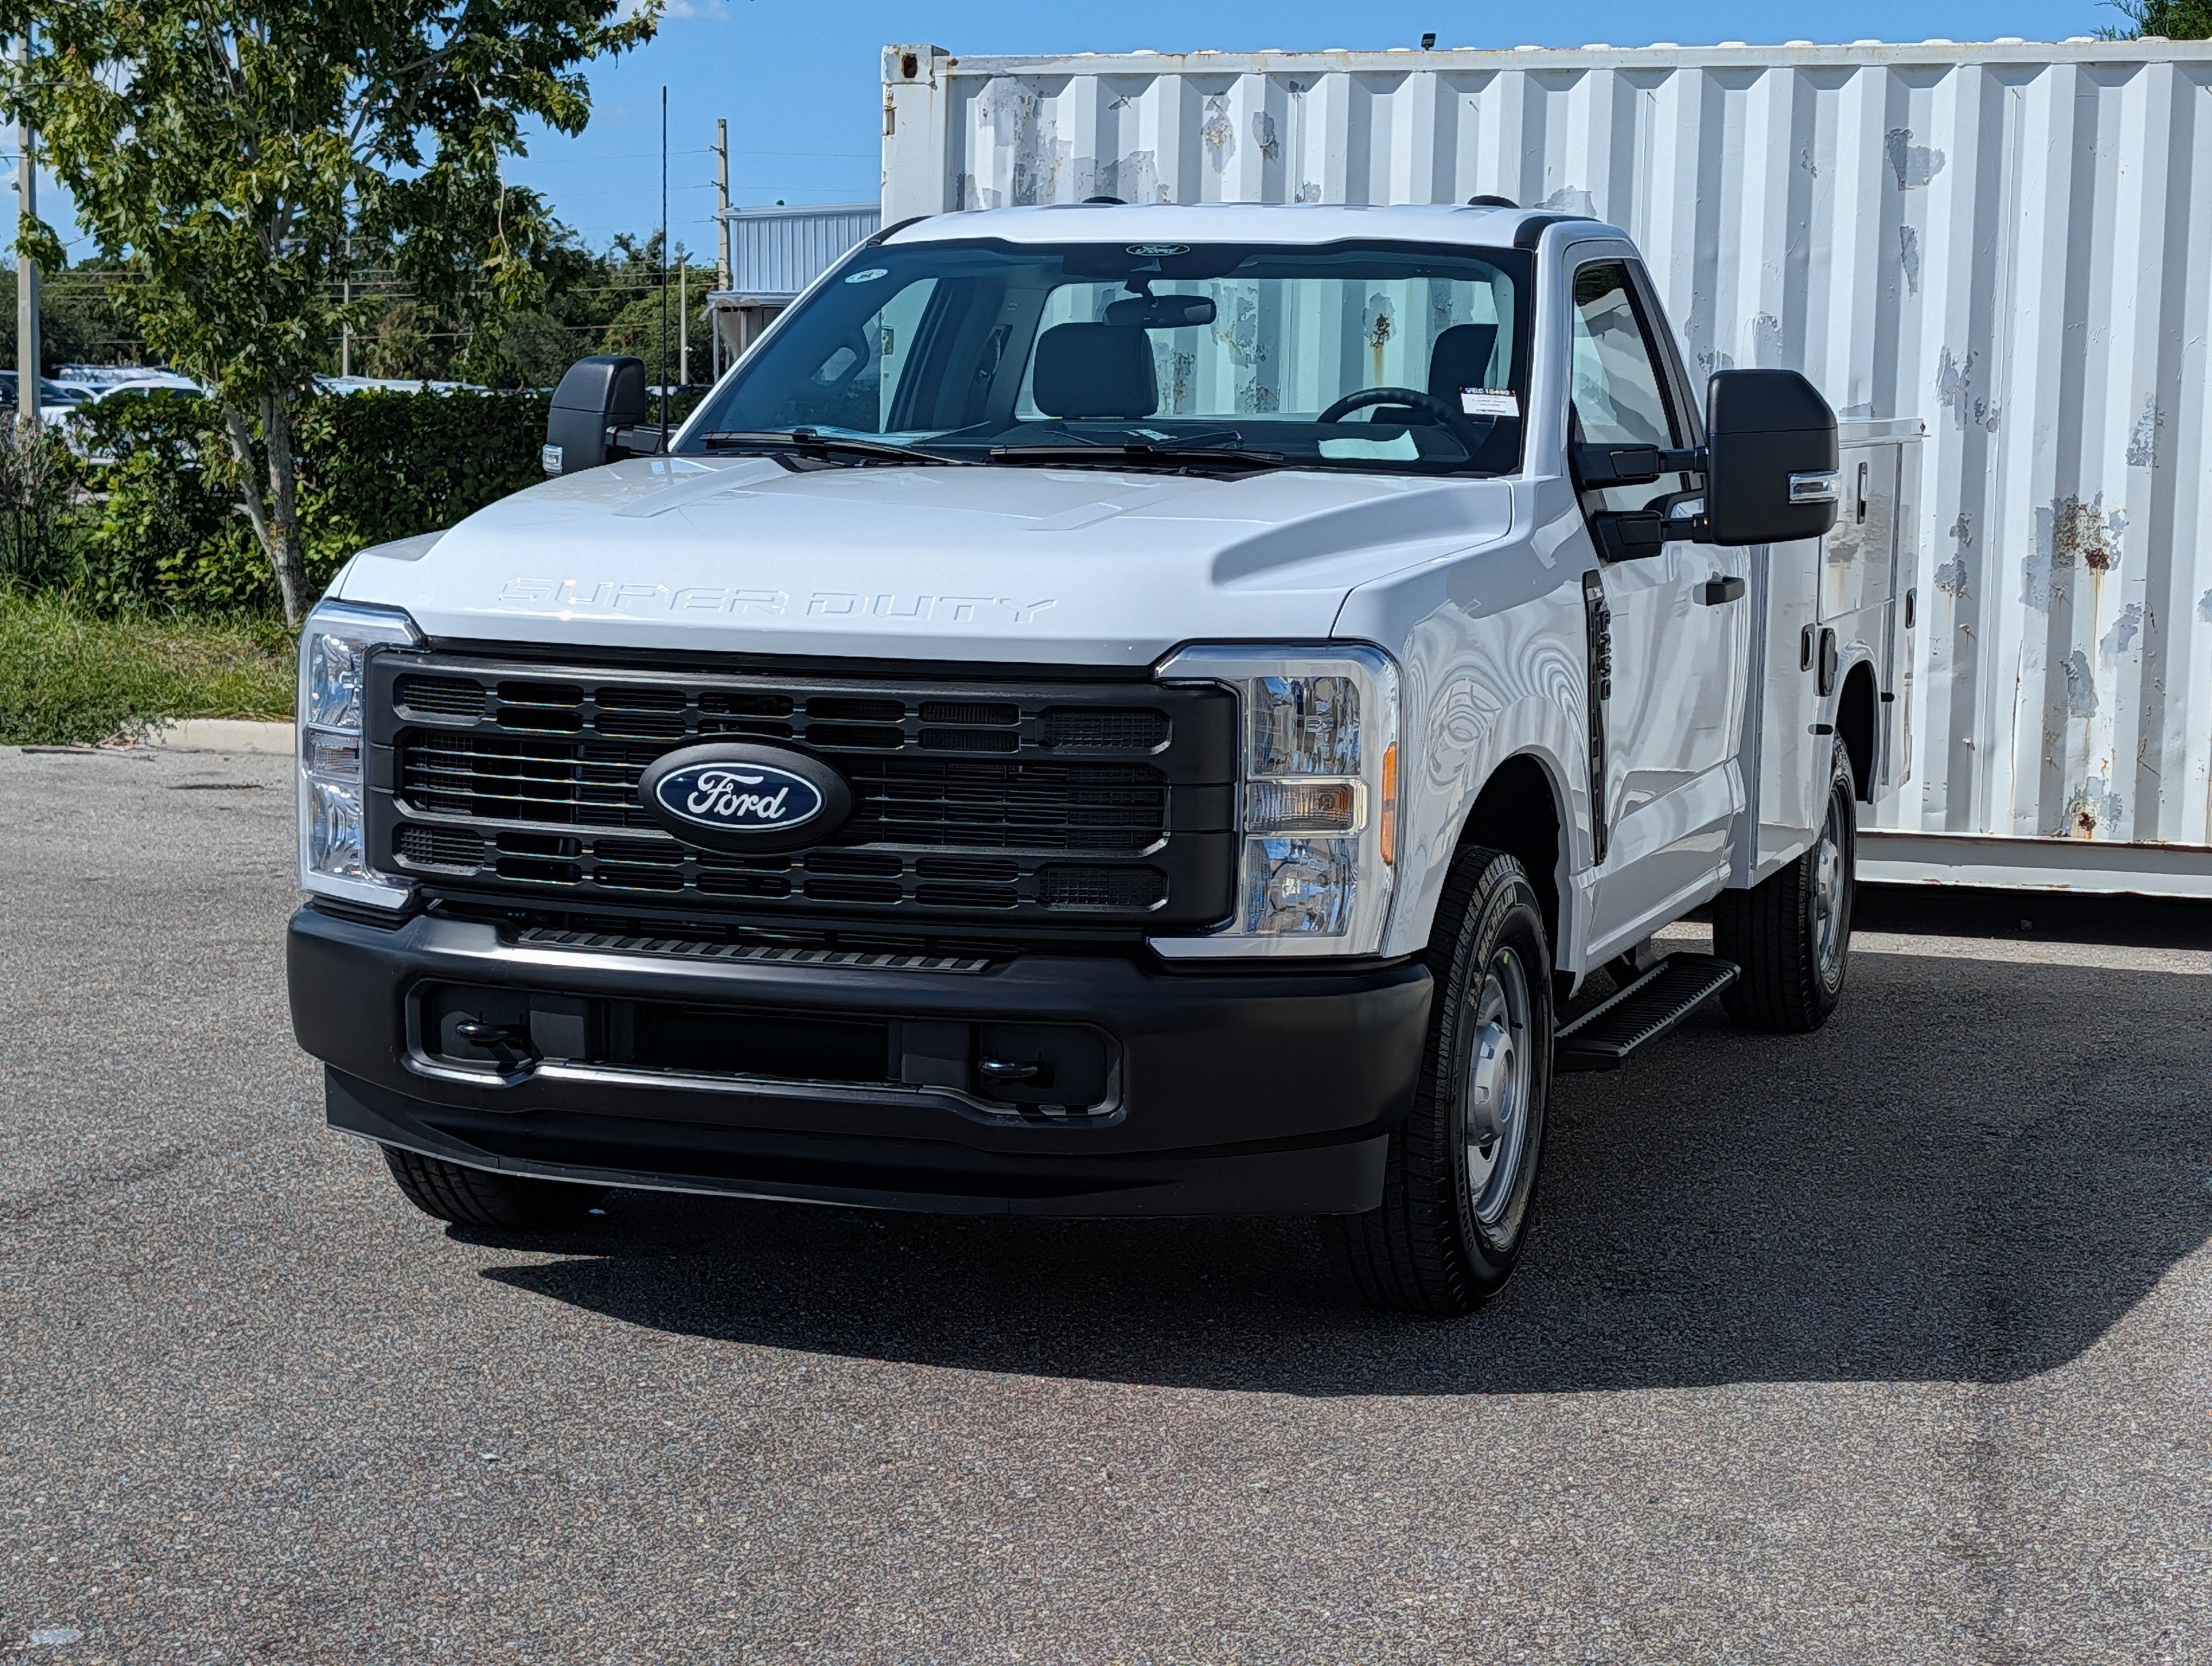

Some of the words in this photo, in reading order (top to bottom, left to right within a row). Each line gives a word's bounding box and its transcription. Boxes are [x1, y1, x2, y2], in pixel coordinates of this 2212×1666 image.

[498, 578, 790, 615] SUPER
[806, 592, 1058, 624] DUTY
[687, 771, 789, 819] Ford
